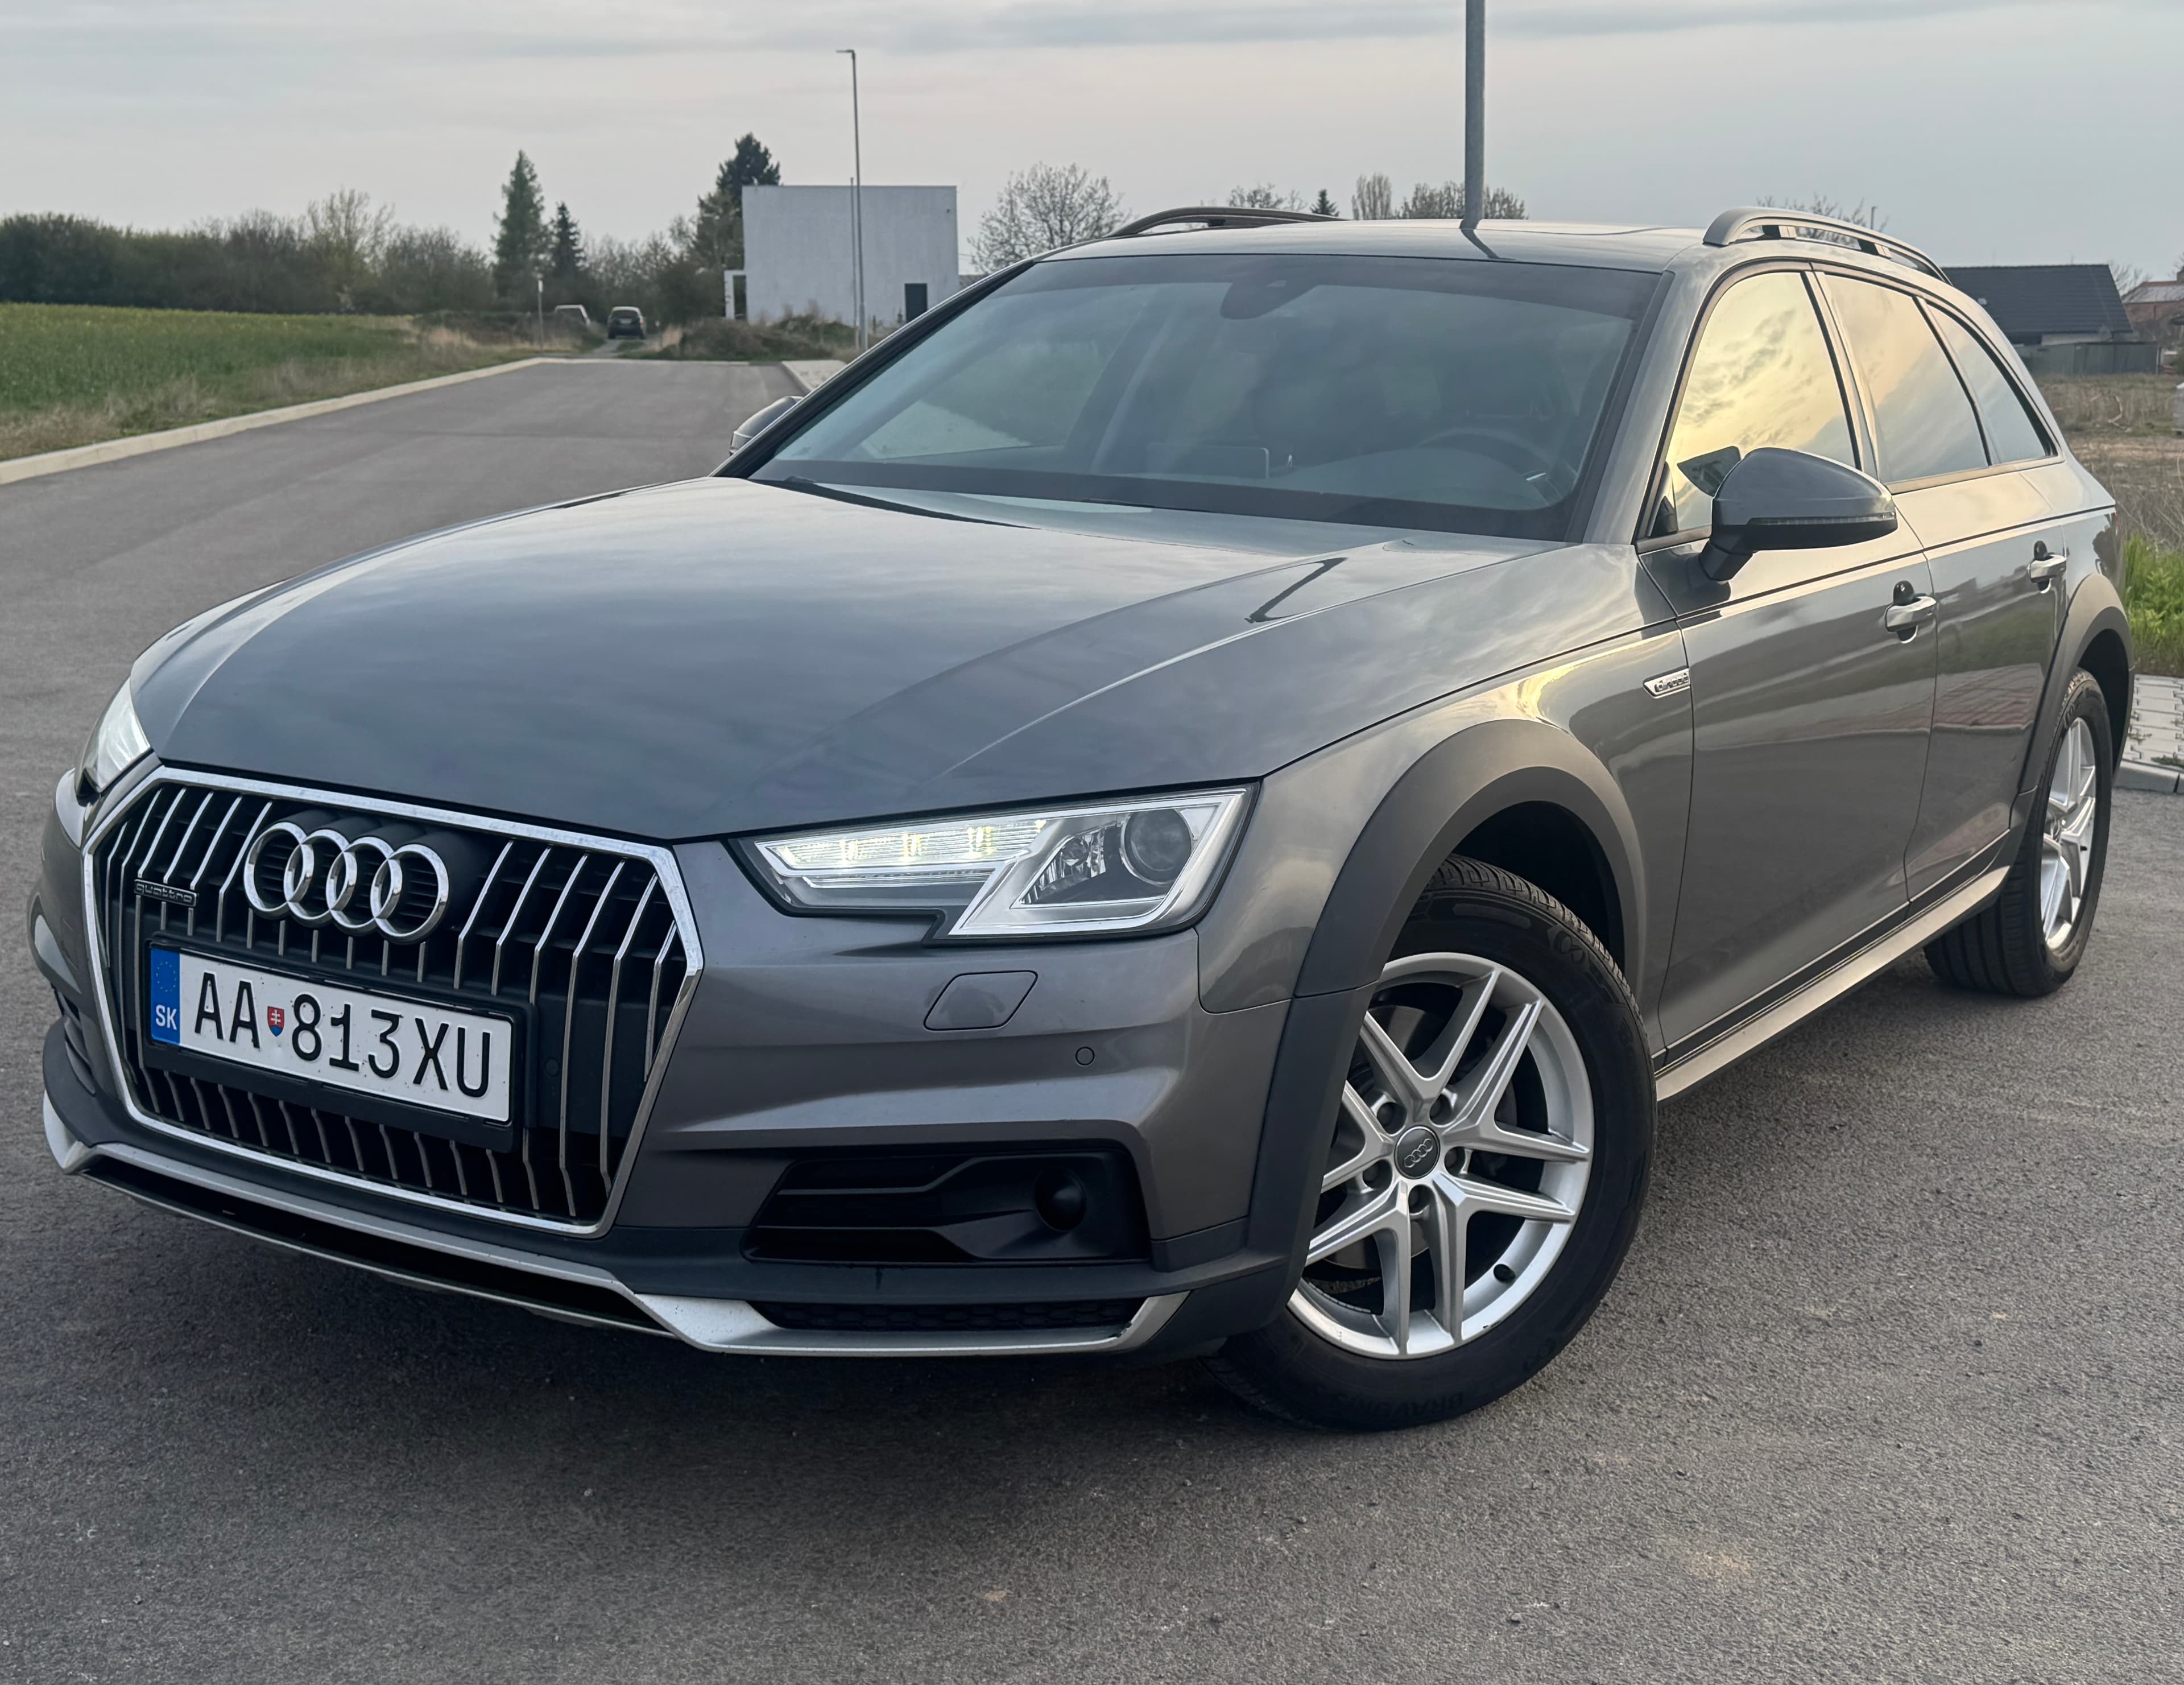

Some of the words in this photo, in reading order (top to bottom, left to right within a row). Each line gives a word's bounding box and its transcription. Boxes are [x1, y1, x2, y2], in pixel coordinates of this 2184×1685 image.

[136, 883, 192, 902] quattro
[155, 1004, 177, 1030] SK
[195, 972, 260, 1049] AA
